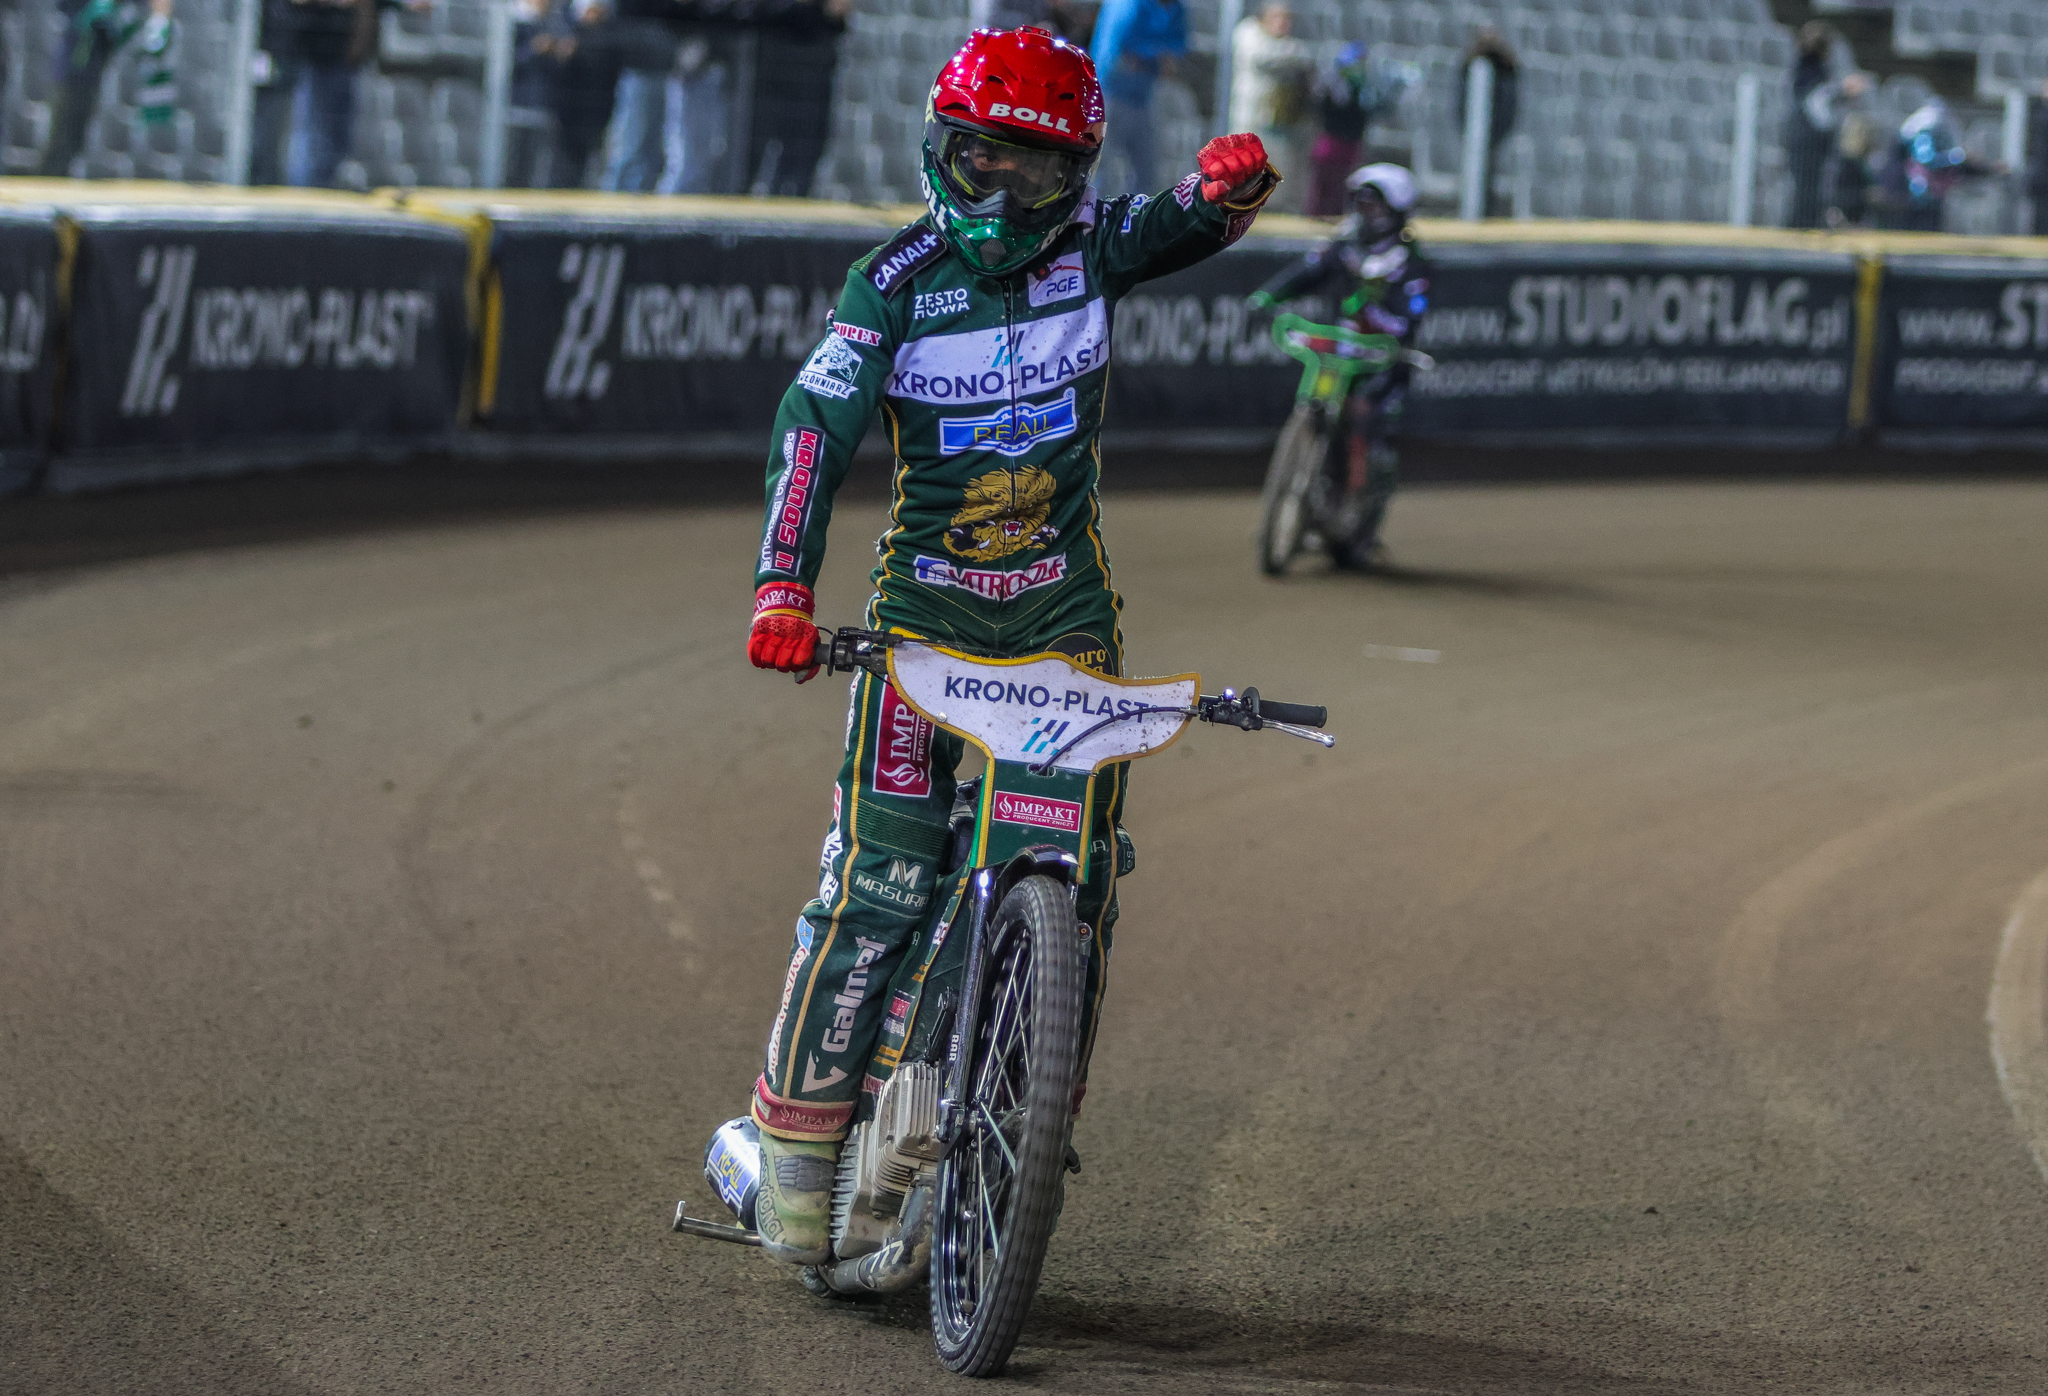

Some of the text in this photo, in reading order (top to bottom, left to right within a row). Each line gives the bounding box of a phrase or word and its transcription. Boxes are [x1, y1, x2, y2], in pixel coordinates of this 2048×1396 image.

[988, 102, 1071, 133] BOLL
[920, 160, 947, 232] OLL
[874, 234, 938, 291] CANAL+
[915, 288, 968, 310] ZESTO
[1046, 275, 1079, 297] PGE
[190, 287, 434, 369] KRONO-PLAST
[893, 343, 1104, 398] KRONO-PLAST
[974, 414, 1053, 443] REALL
[778, 430, 818, 547] KRONOS
[756, 589, 806, 611] IMPAKT
[945, 675, 1152, 723] KRONO-PLAST
[1013, 801, 1076, 820] IMPAKT
[1013, 814, 1074, 828] PRODUCENT ZNICZY
[821, 935, 887, 1053] Galmet
